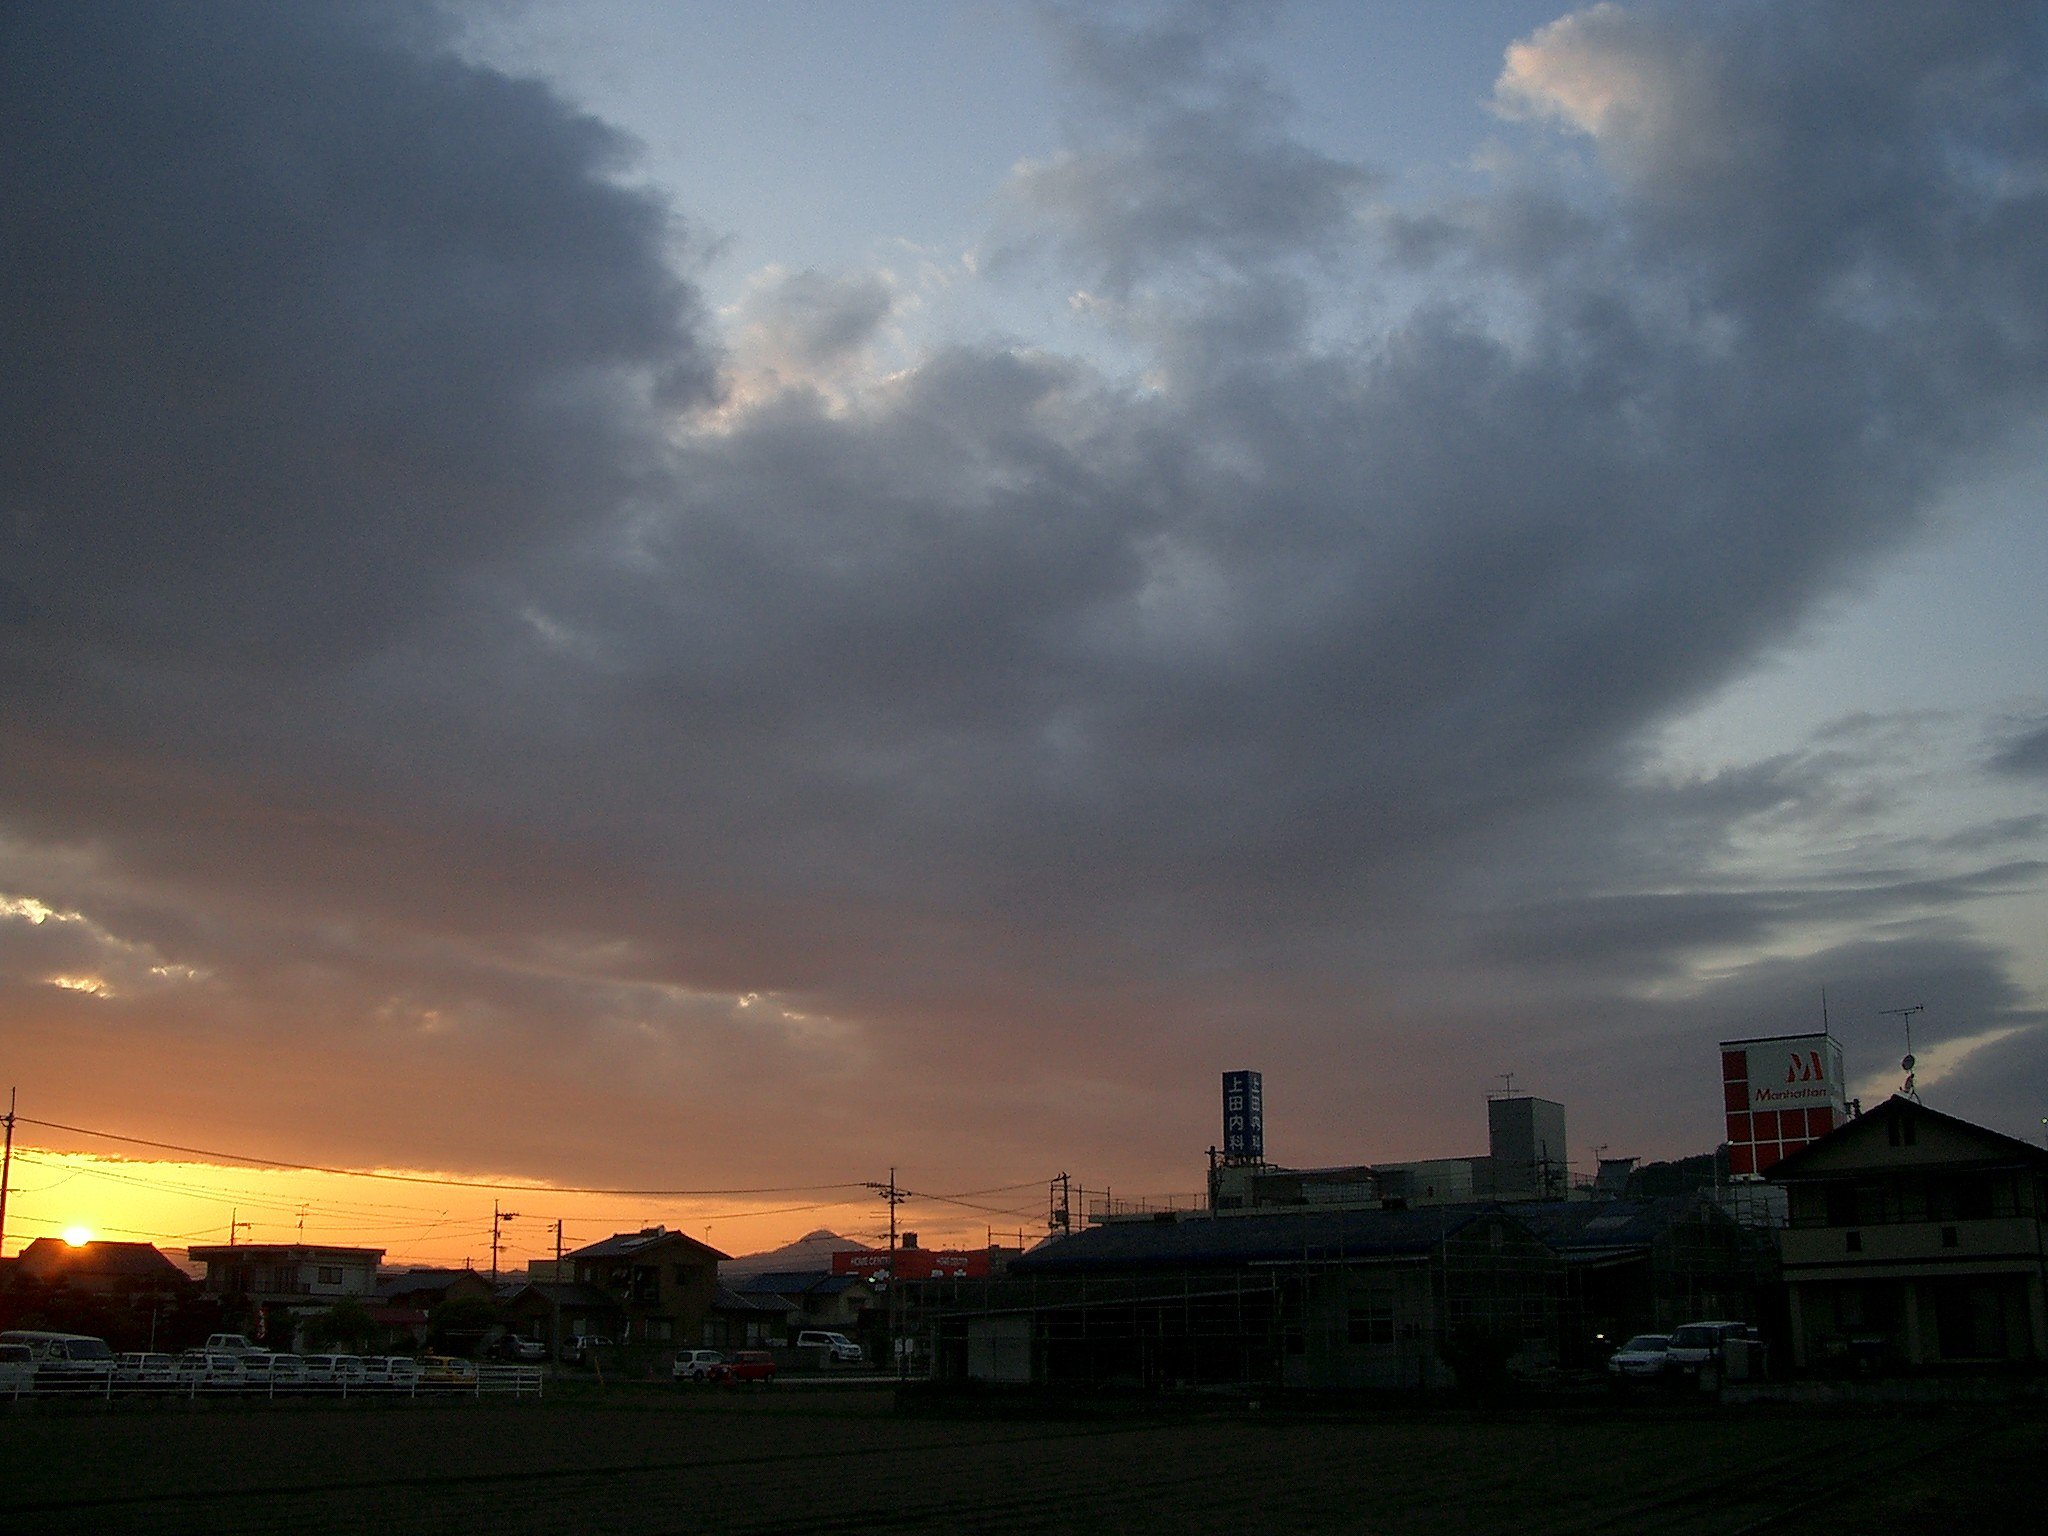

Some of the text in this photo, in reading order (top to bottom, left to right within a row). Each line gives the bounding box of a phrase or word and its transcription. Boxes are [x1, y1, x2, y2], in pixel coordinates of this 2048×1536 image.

[1228, 1077, 1244, 1151] 上田内科
[1755, 1087, 1827, 1101] Manhattan
